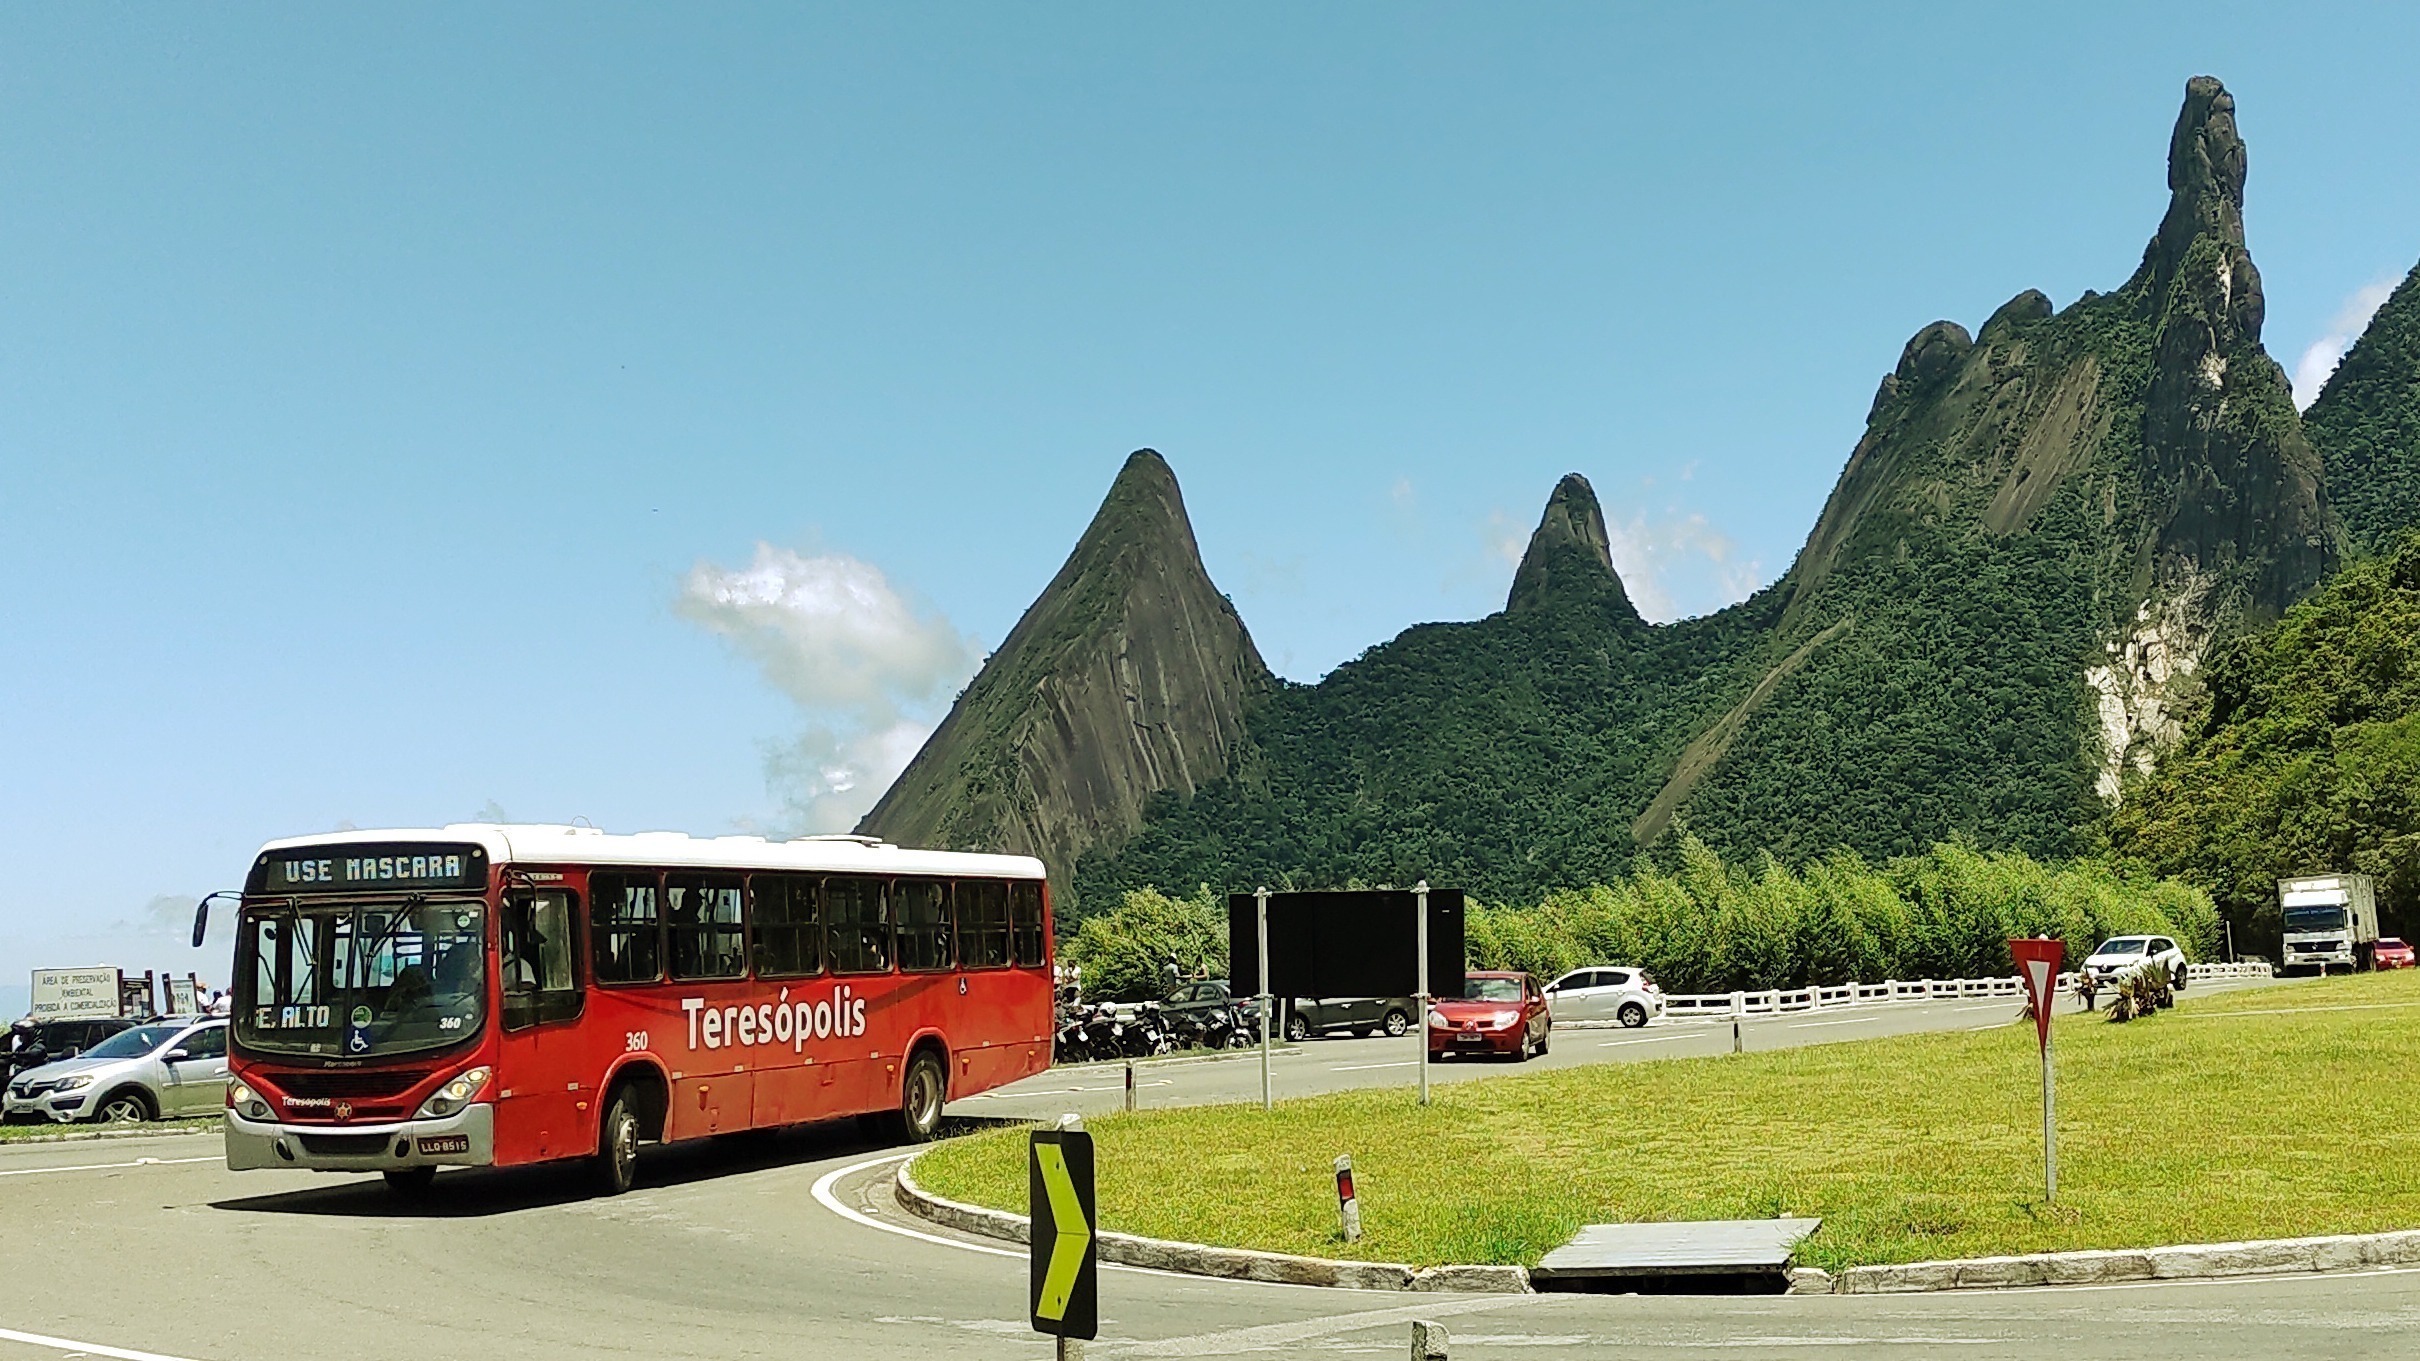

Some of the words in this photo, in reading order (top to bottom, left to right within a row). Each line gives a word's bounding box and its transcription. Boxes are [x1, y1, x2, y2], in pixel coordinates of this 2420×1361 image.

[285, 859, 333, 883] USE
[346, 855, 461, 881] MASCARA
[281, 1005, 330, 1029] ALTO
[439, 1017, 462, 1030] 360
[681, 985, 867, 1054] Teresópolis
[625, 1031, 648, 1052] 360
